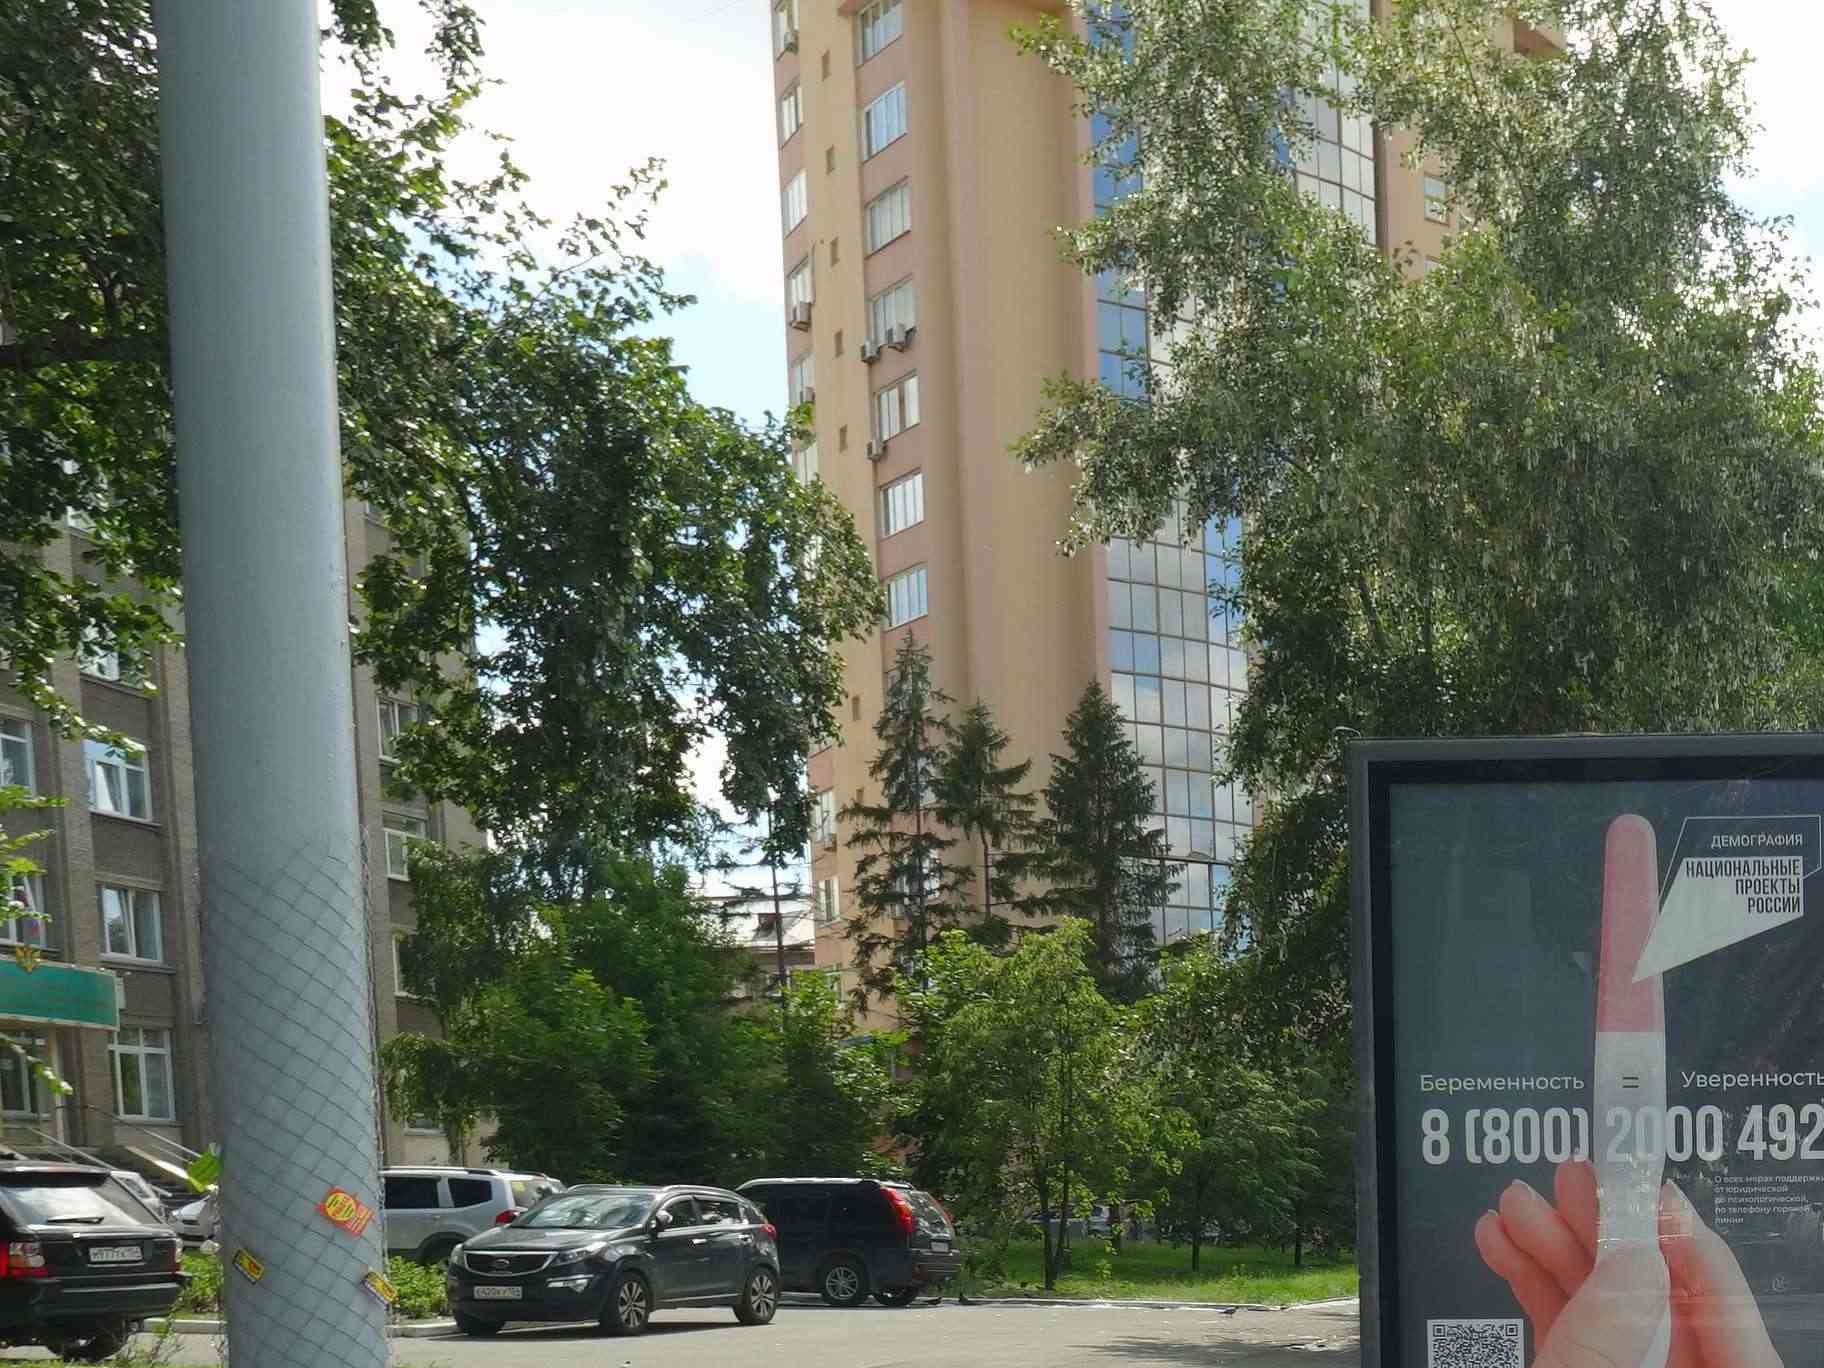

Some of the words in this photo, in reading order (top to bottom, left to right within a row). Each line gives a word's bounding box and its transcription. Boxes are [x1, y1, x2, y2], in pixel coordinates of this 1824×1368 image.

[1711, 833, 1803, 849] ДЕМОГРАФИЯ
[1685, 858, 1801, 879] НАЦИОНАЛЬНЫЕ
[1735, 878, 1801, 895] ПРОЕКТЫ
[1747, 896, 1801, 913] РОССИИ
[1419, 1074, 1585, 1095] Беременность
[1421, 1108, 1450, 1165] 8
[1604, 1104, 1724, 1162] 2000
